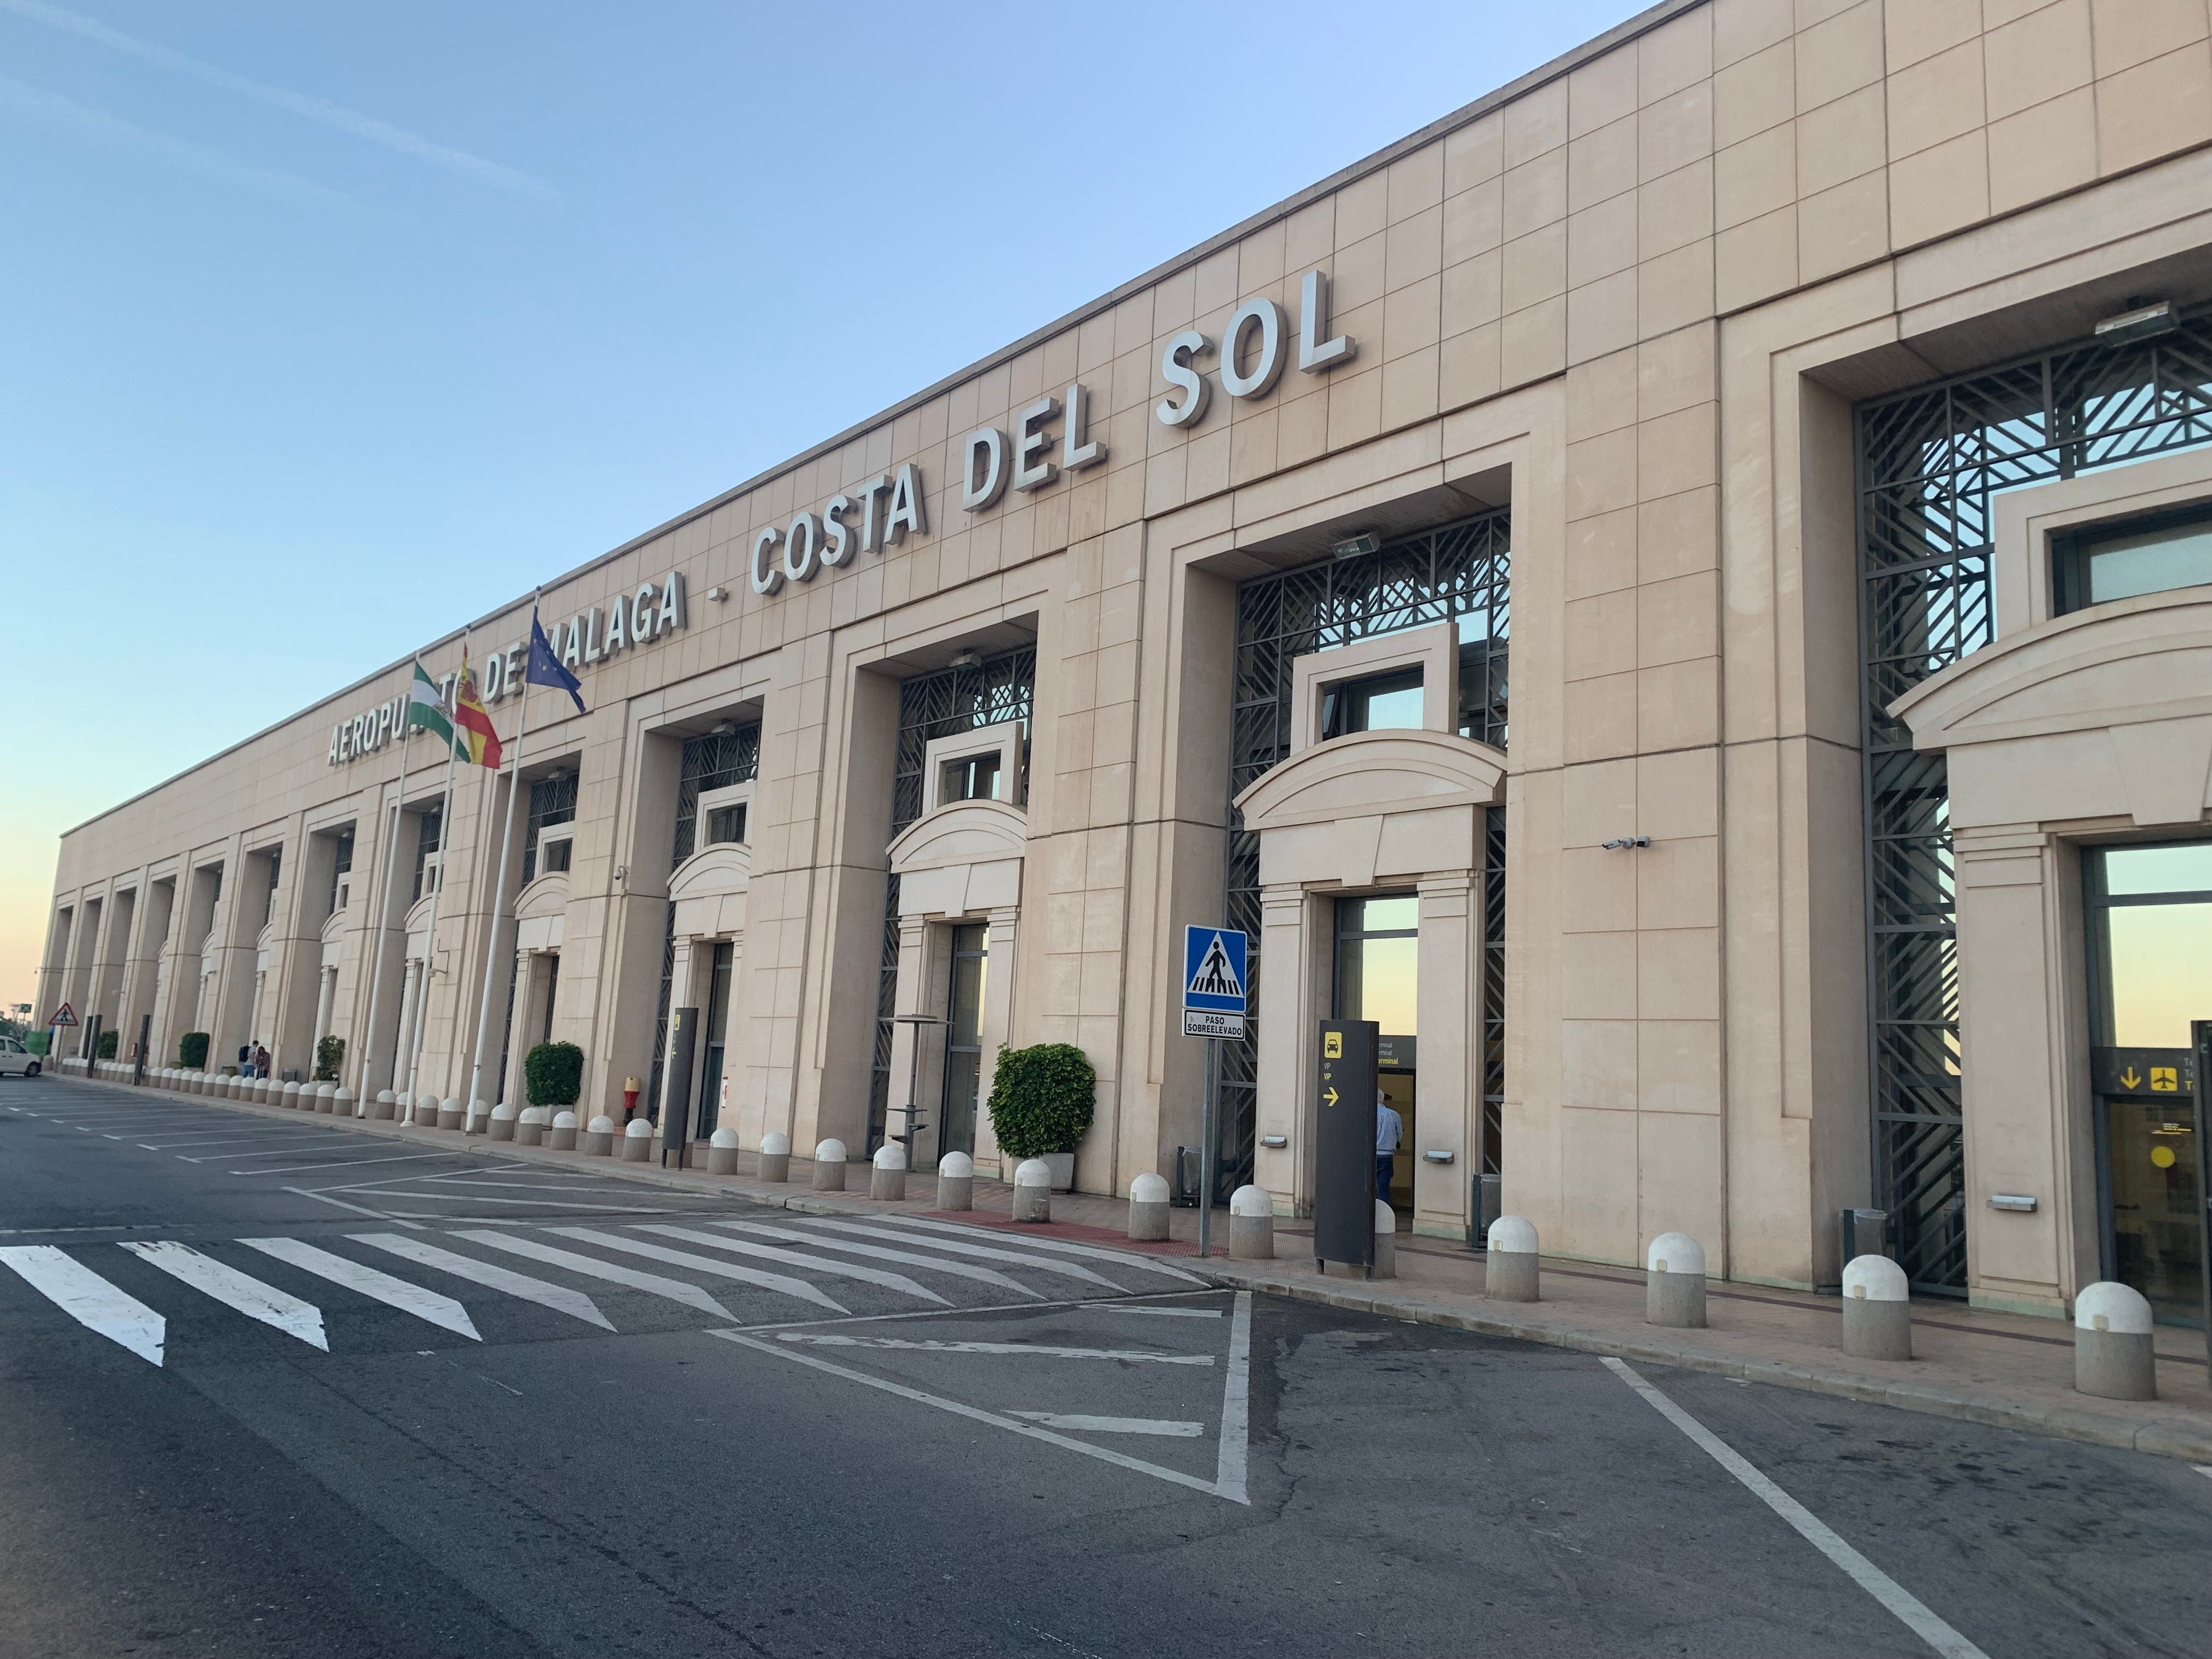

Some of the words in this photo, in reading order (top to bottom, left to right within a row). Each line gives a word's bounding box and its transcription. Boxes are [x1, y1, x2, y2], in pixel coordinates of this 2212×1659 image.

[328, 668, 475, 766] AEROPUT
[483, 641, 527, 703] DE
[543, 571, 685, 667] MALAGA
[751, 463, 927, 595] COSTA
[962, 383, 1107, 512] DEL
[1155, 269, 1356, 428] SOL
[1205, 1015, 1224, 1025] PASO
[1187, 1023, 1242, 1036] SOBREELEVADO
